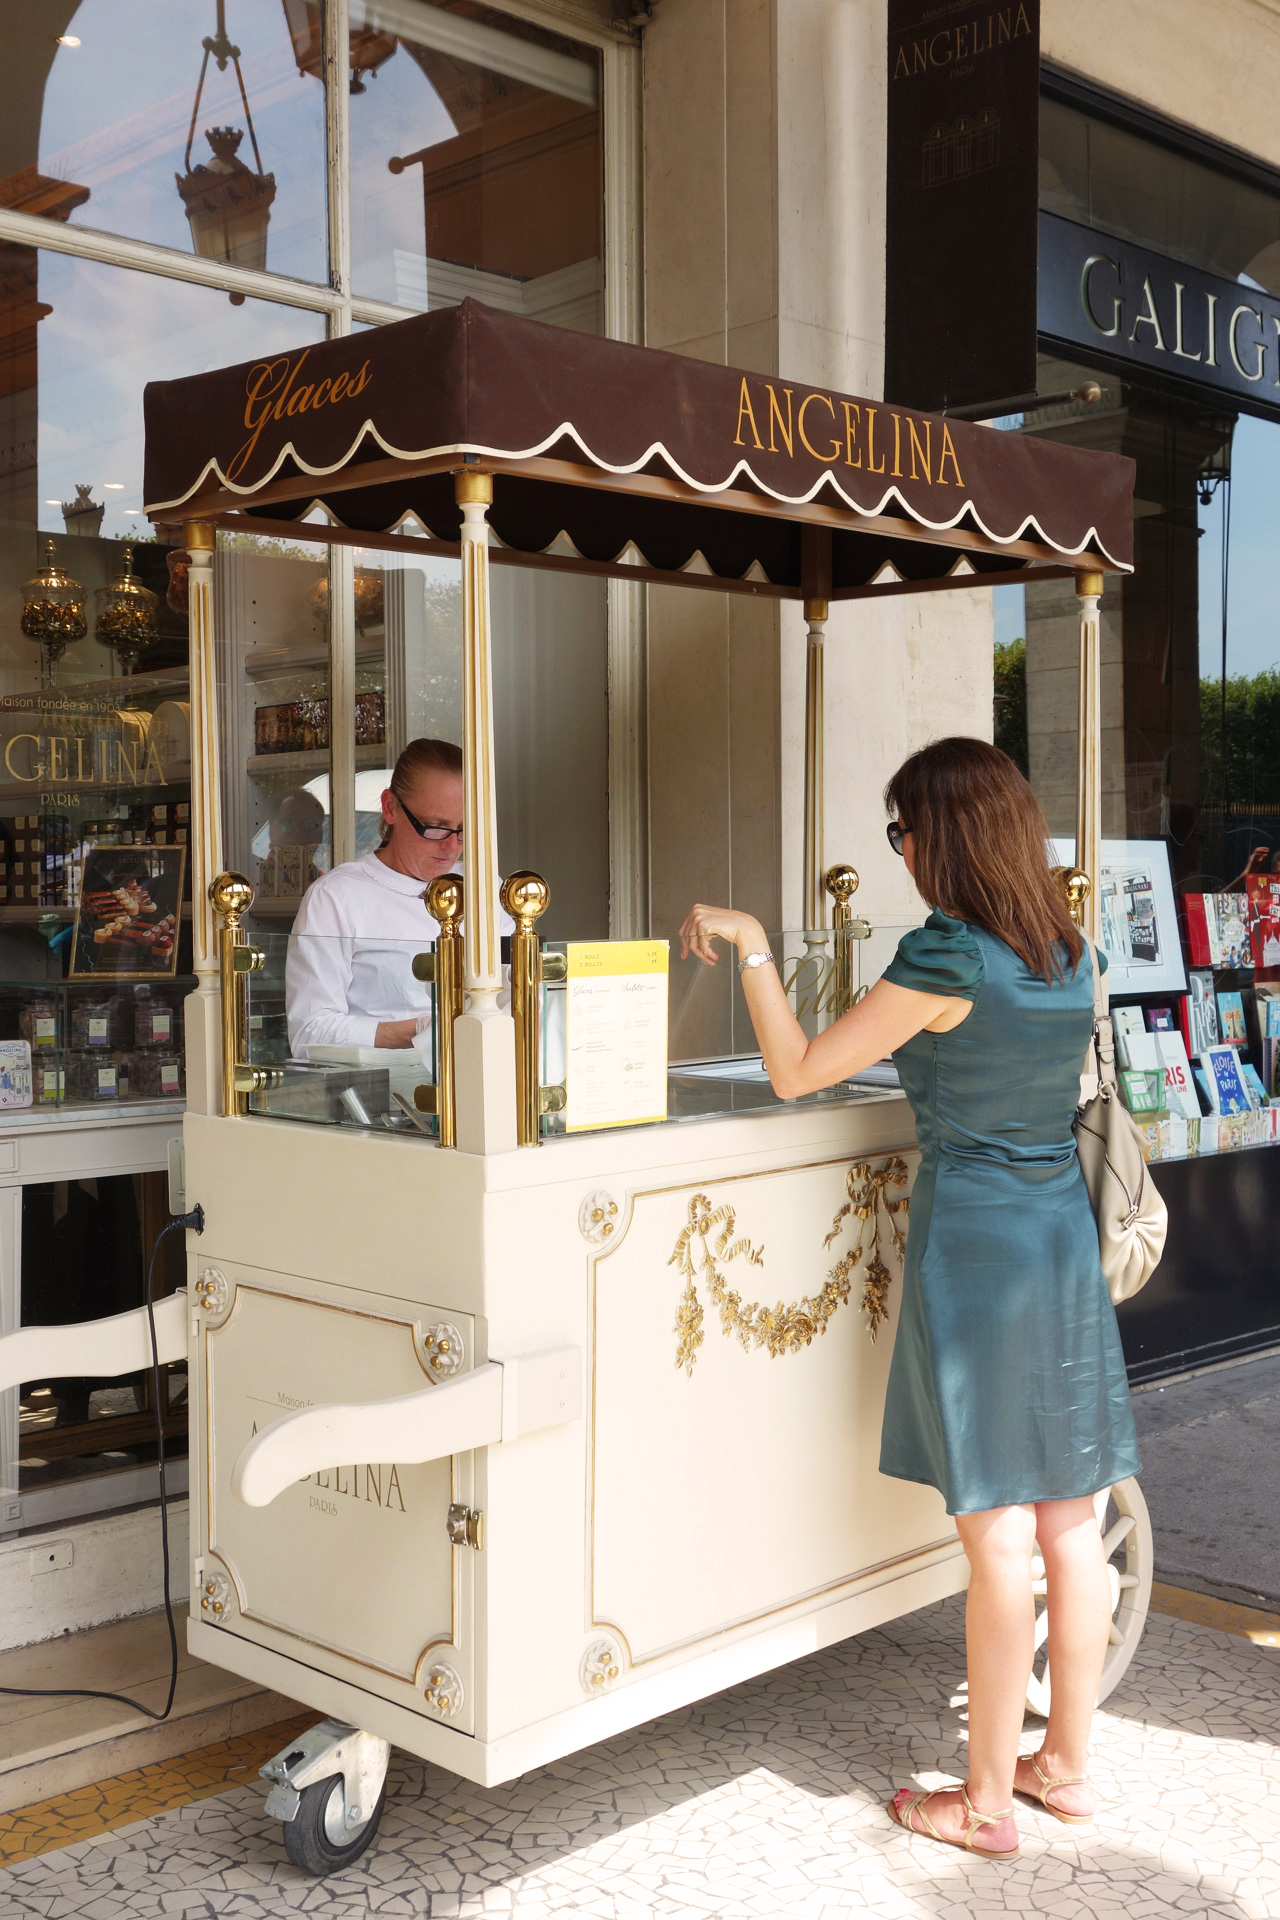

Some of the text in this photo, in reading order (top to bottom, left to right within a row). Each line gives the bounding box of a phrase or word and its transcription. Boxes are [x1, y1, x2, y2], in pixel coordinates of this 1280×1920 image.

[893, 1, 1032, 80] ANGELINA
[1080, 252, 1280, 387] GALIG
[225, 348, 373, 482] Glaces
[733, 376, 966, 488] ANGELINA
[79, 701, 94, 712] en
[0, 733, 169, 786] GELINA
[40, 793, 80, 807] PARIS
[779, 956, 870, 1021] Glac
[1162, 1066, 1186, 1086] RIS
[1220, 1079, 1237, 1093] PARIS
[277, 1391, 305, 1409] Maison
[309, 1495, 338, 1517] PARIS
